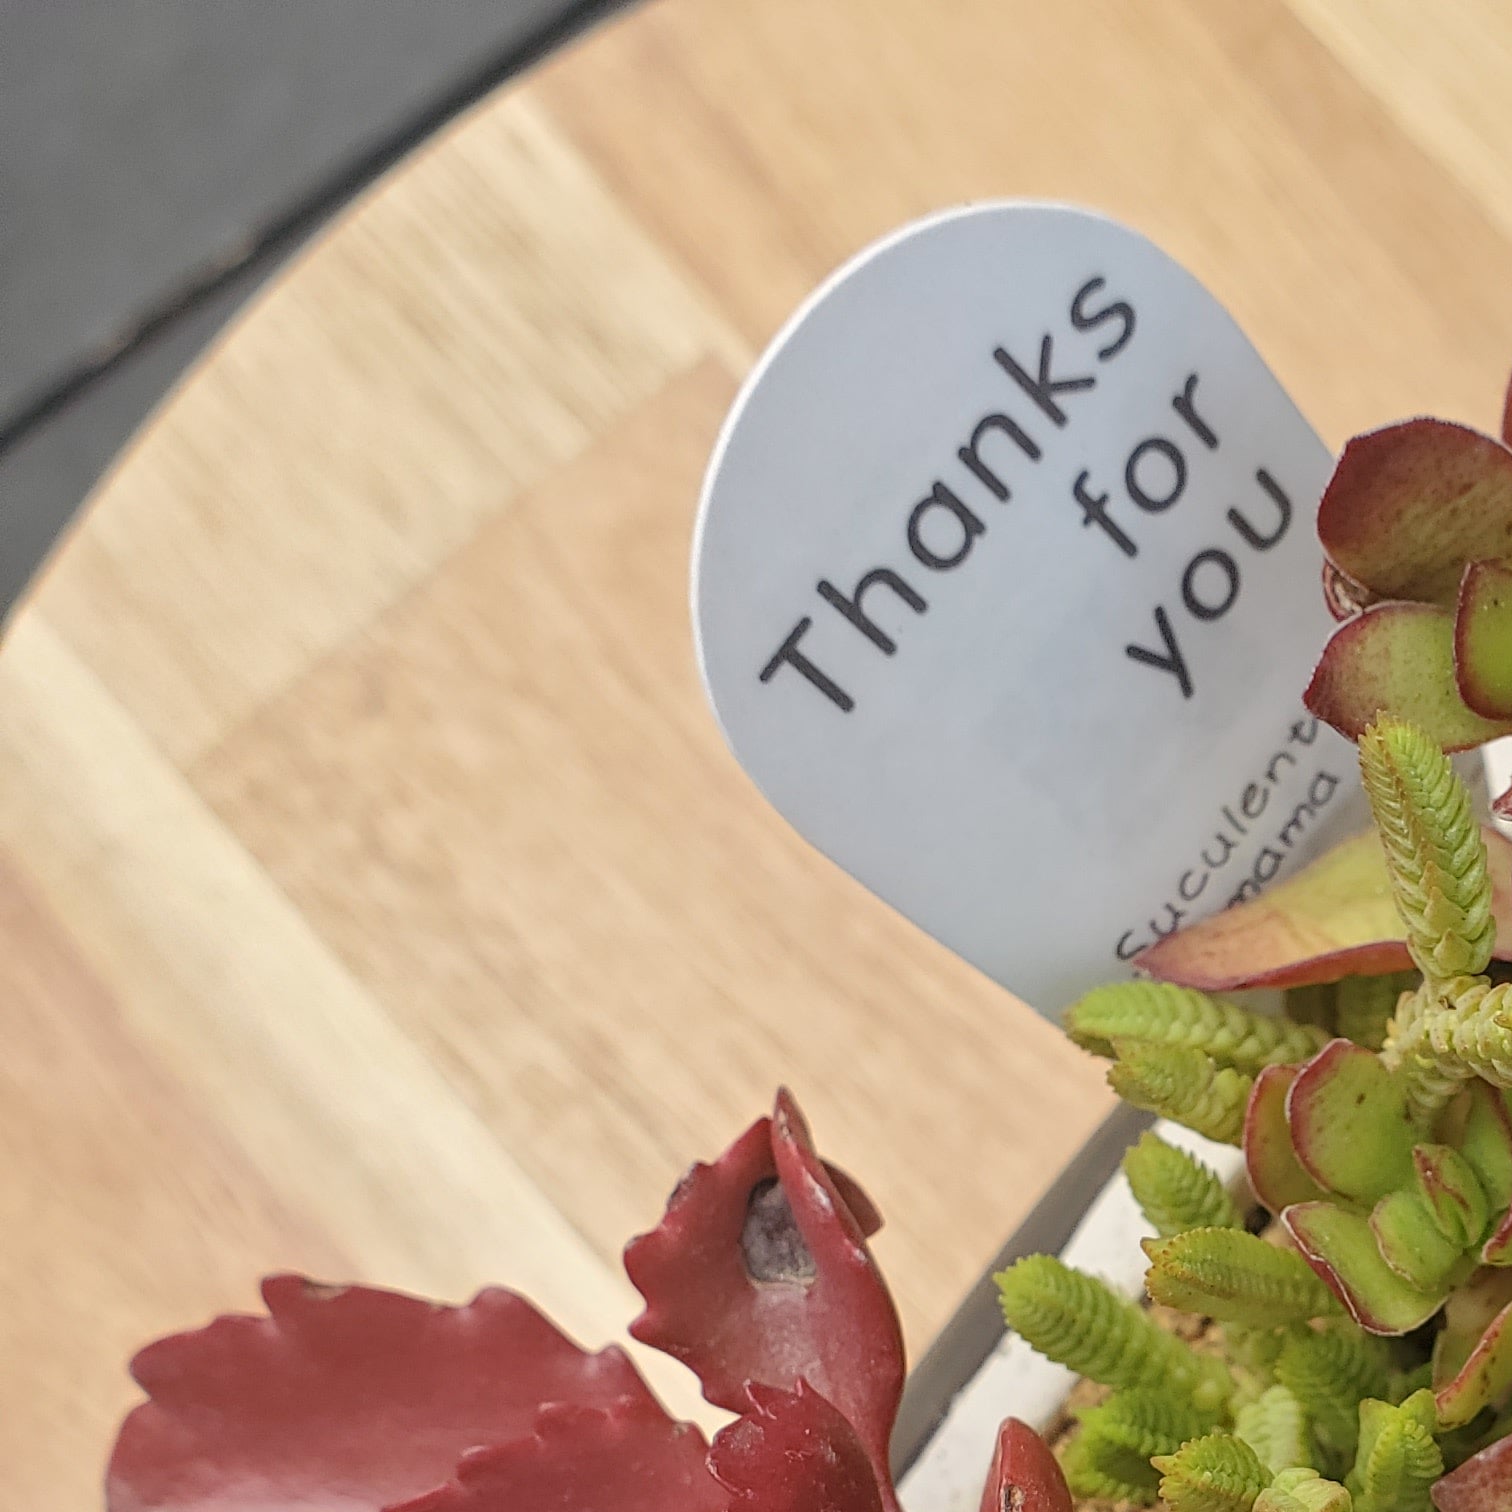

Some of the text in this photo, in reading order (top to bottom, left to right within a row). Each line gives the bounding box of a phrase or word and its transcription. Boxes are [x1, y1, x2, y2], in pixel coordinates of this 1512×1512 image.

[760, 275, 1136, 713] Thanks
[1072, 373, 1220, 558] for
[1126, 467, 1293, 698] you
